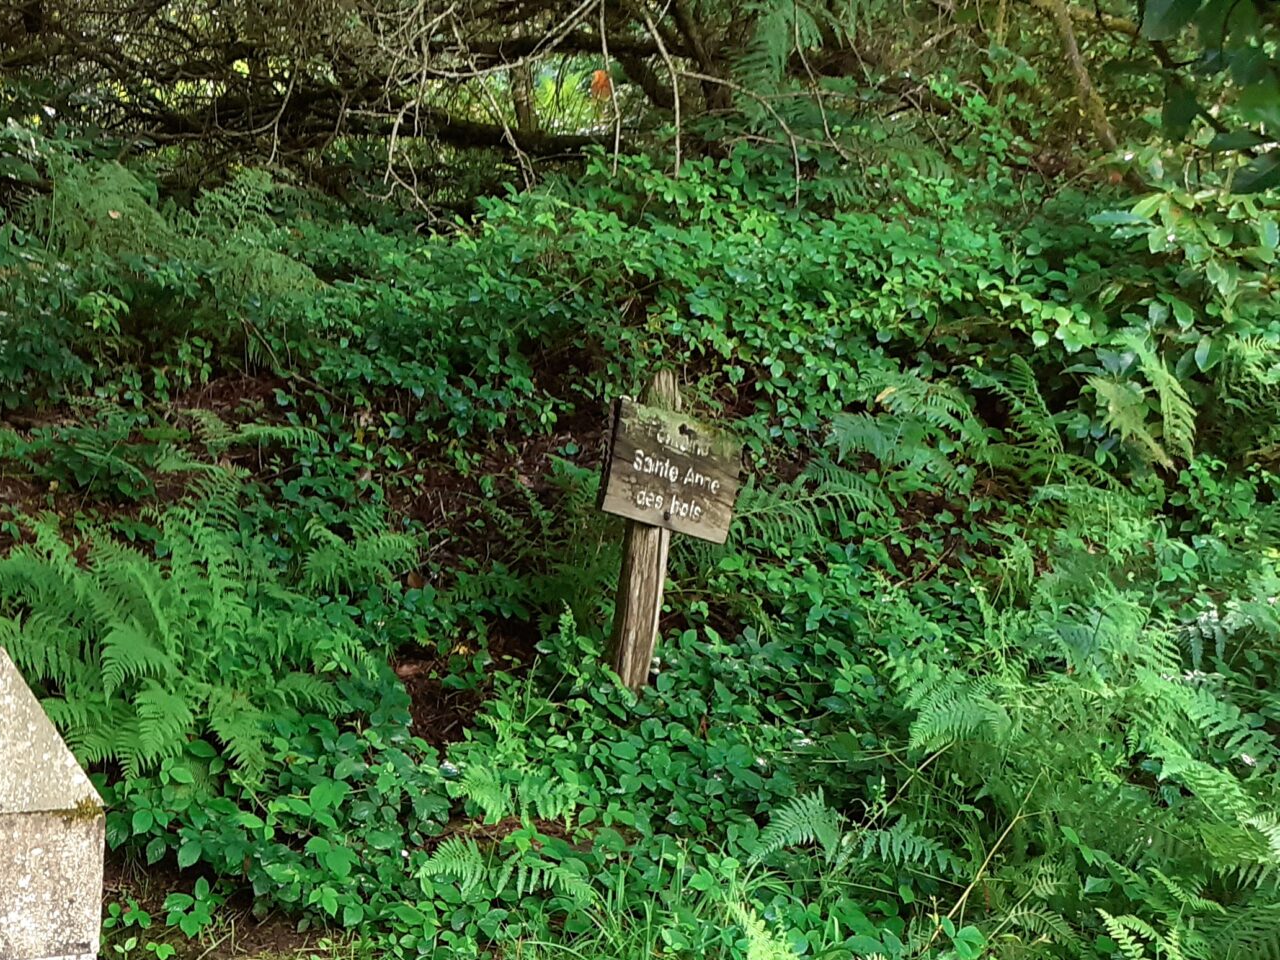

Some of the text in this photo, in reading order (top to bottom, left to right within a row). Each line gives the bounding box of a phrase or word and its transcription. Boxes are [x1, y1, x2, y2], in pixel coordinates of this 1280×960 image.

[633, 449, 720, 494] Sainte Anne
[636, 488, 702, 519] des bois
